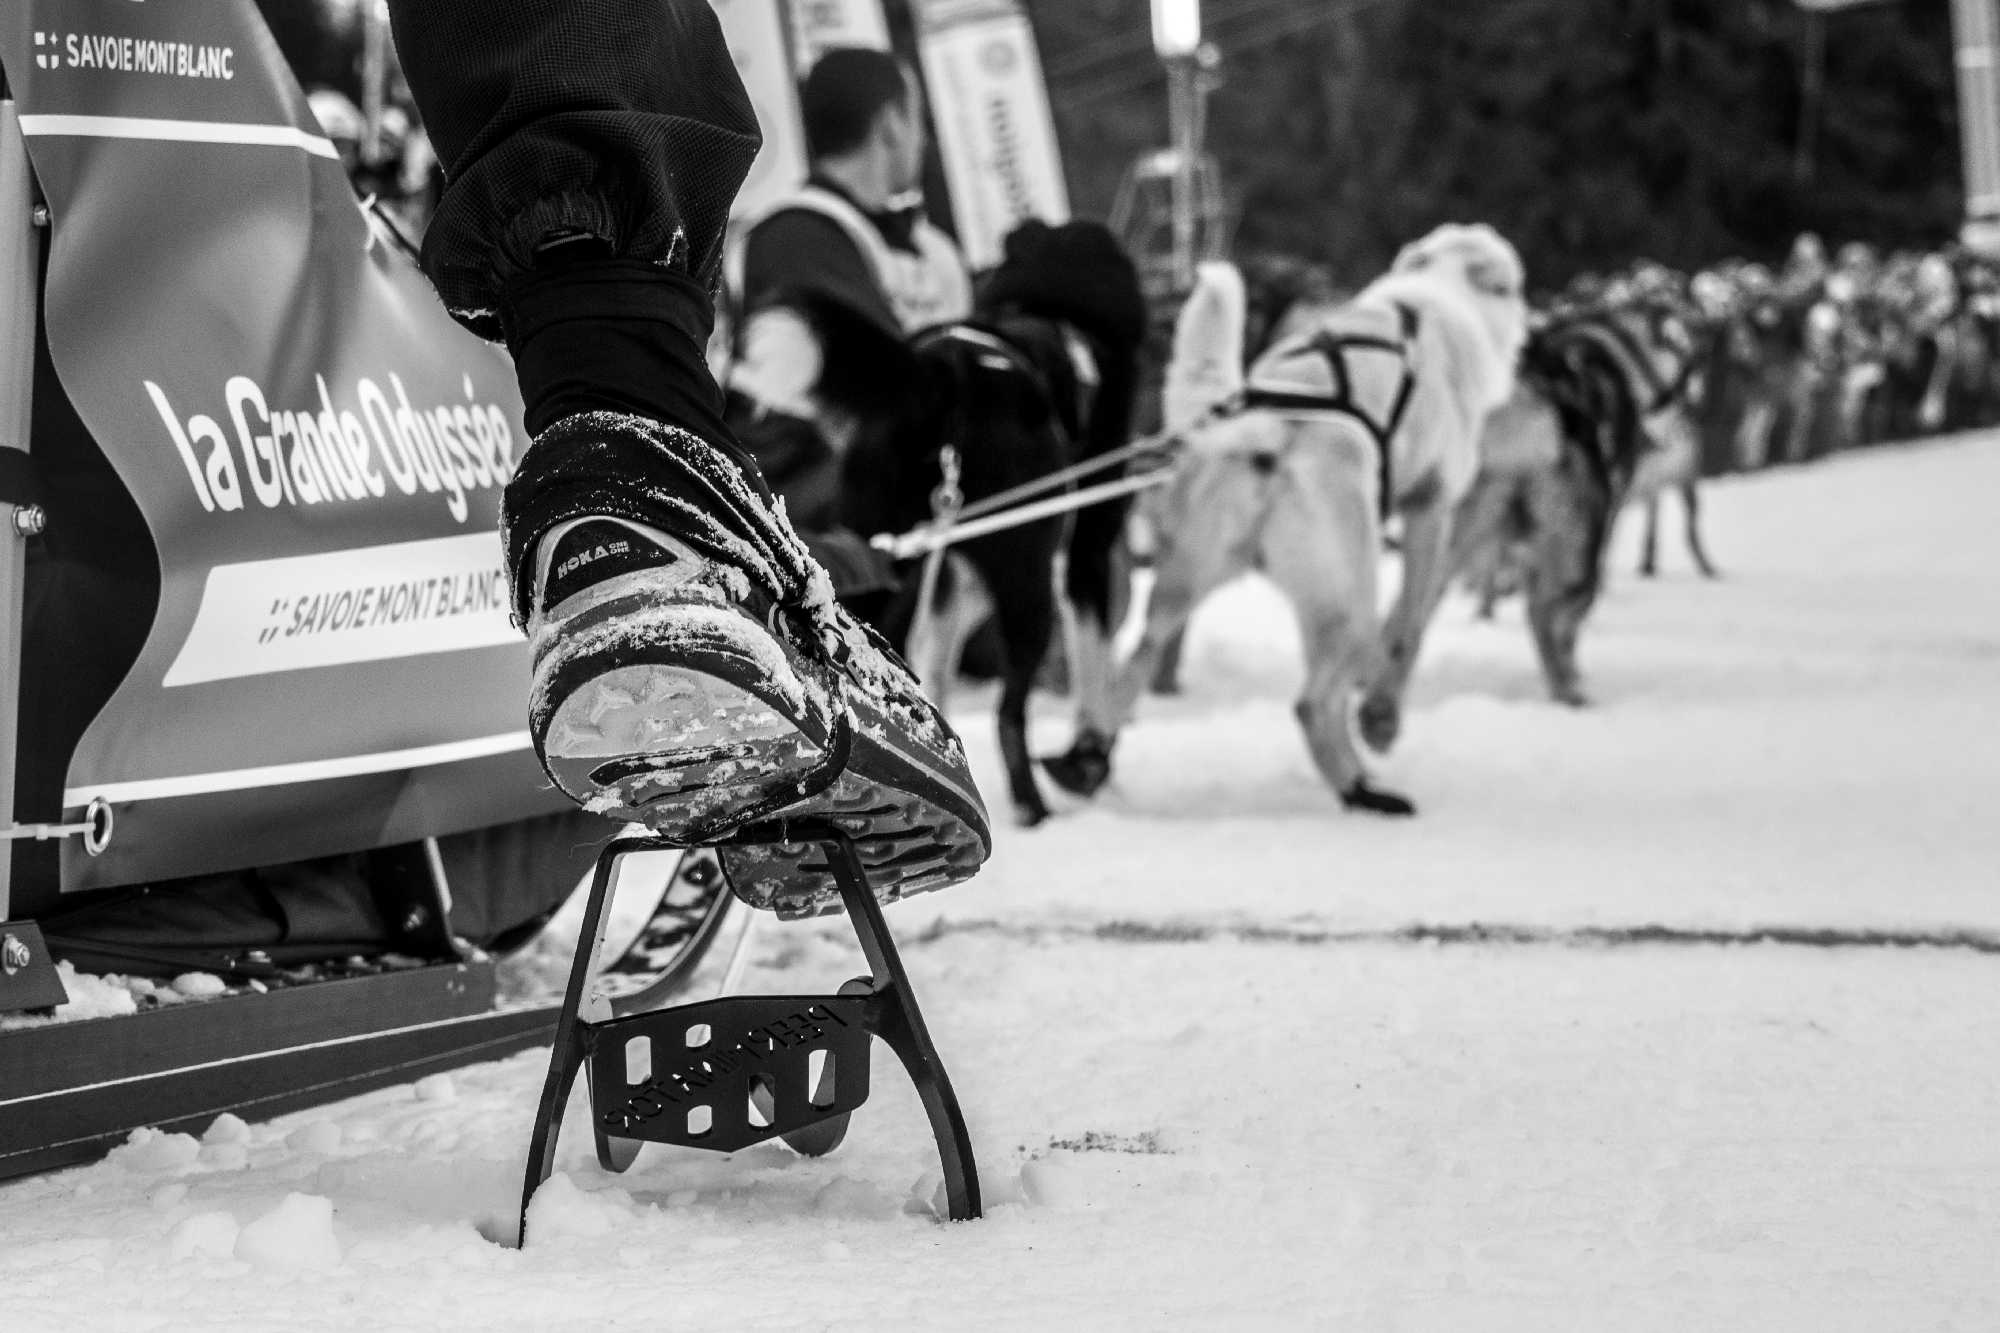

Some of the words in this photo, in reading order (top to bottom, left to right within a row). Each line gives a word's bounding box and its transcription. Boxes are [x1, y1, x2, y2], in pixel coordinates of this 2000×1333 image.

[66, 33, 133, 71] SAVOIE
[134, 39, 177, 75] MONT
[177, 43, 234, 80] BLANC
[143, 379, 244, 513] la
[225, 372, 386, 508] Grande
[357, 371, 519, 523] Odyssée
[558, 545, 609, 580] HOKA
[285, 587, 374, 637] SAVOIE
[369, 579, 437, 627] MONT
[435, 569, 501, 618] BLANC
